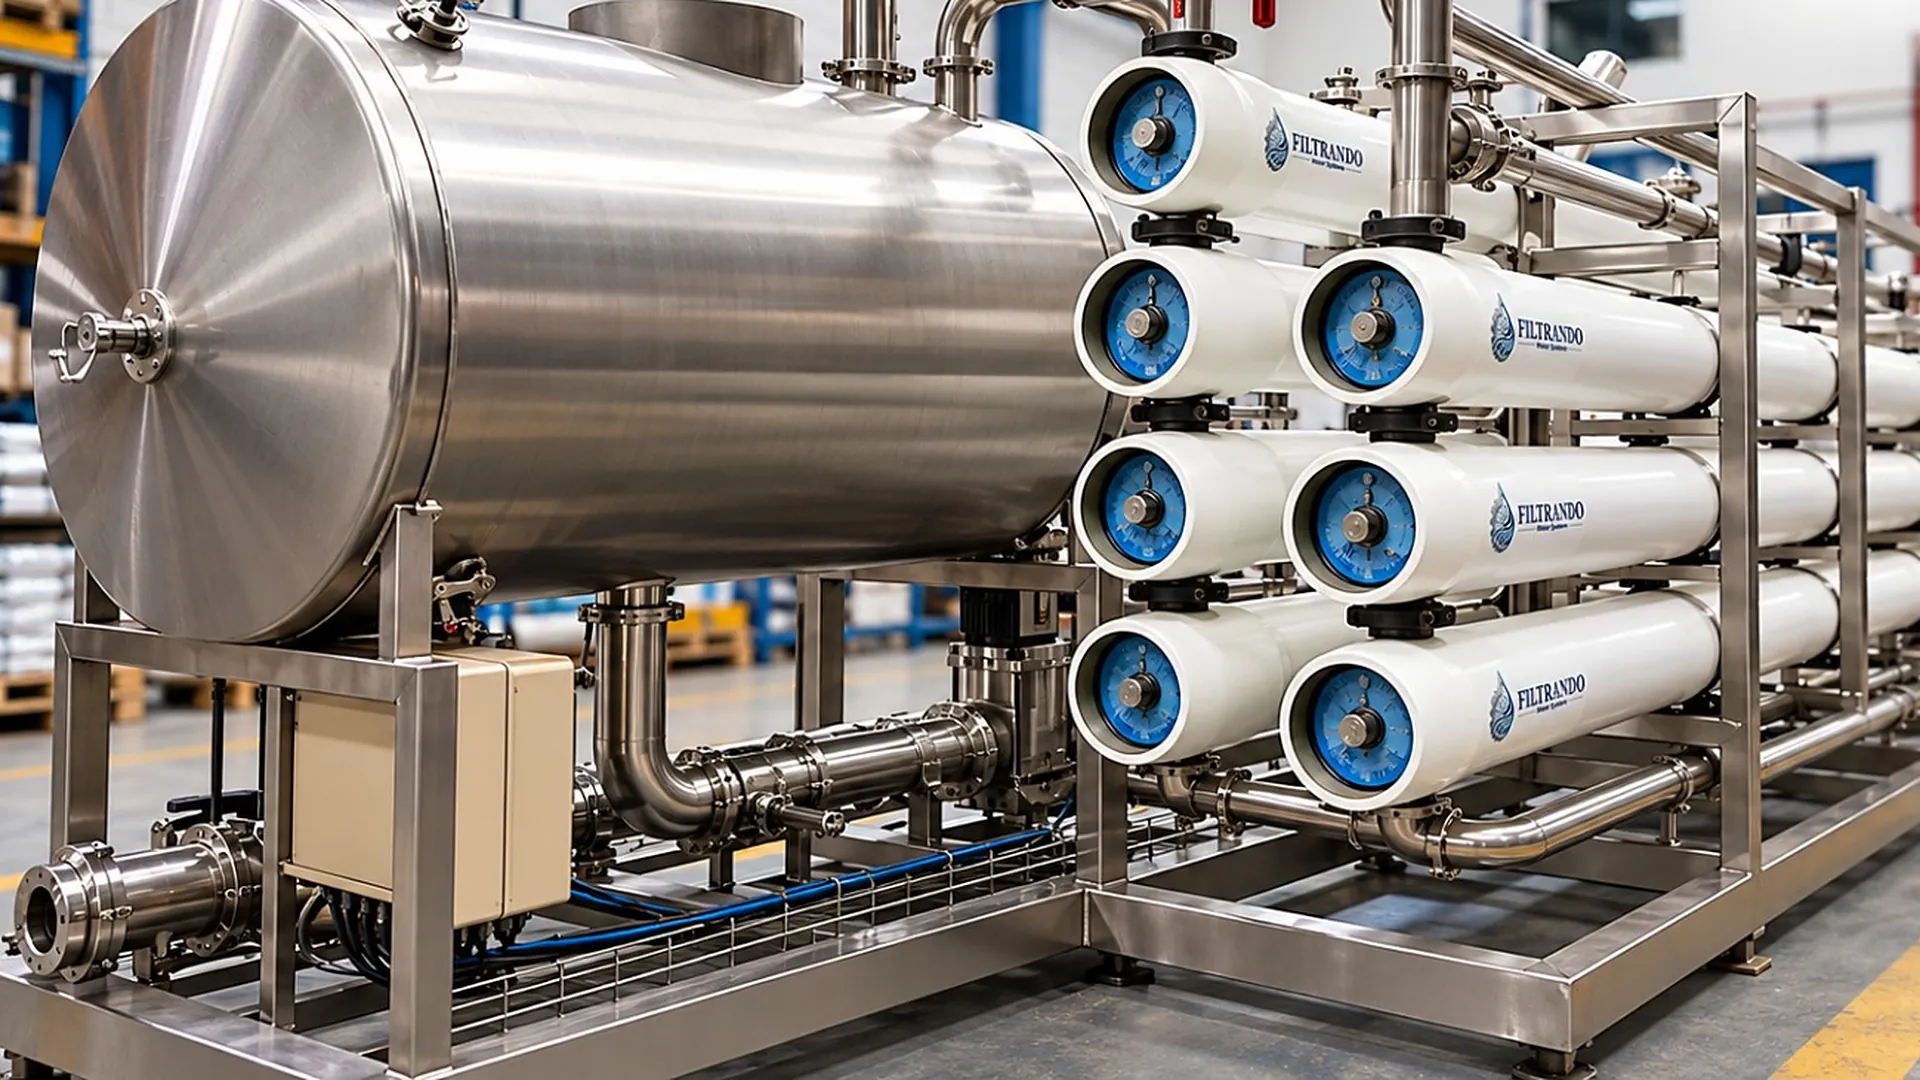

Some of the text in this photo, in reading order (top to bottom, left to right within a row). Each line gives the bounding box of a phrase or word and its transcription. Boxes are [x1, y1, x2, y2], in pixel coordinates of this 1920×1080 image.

[1292, 132, 1363, 167] FILTRANDO
[1517, 318, 1584, 345] FILTRANDO
[1517, 501, 1584, 524] FILTRANDO
[1517, 674, 1585, 710] FILTRANDO
